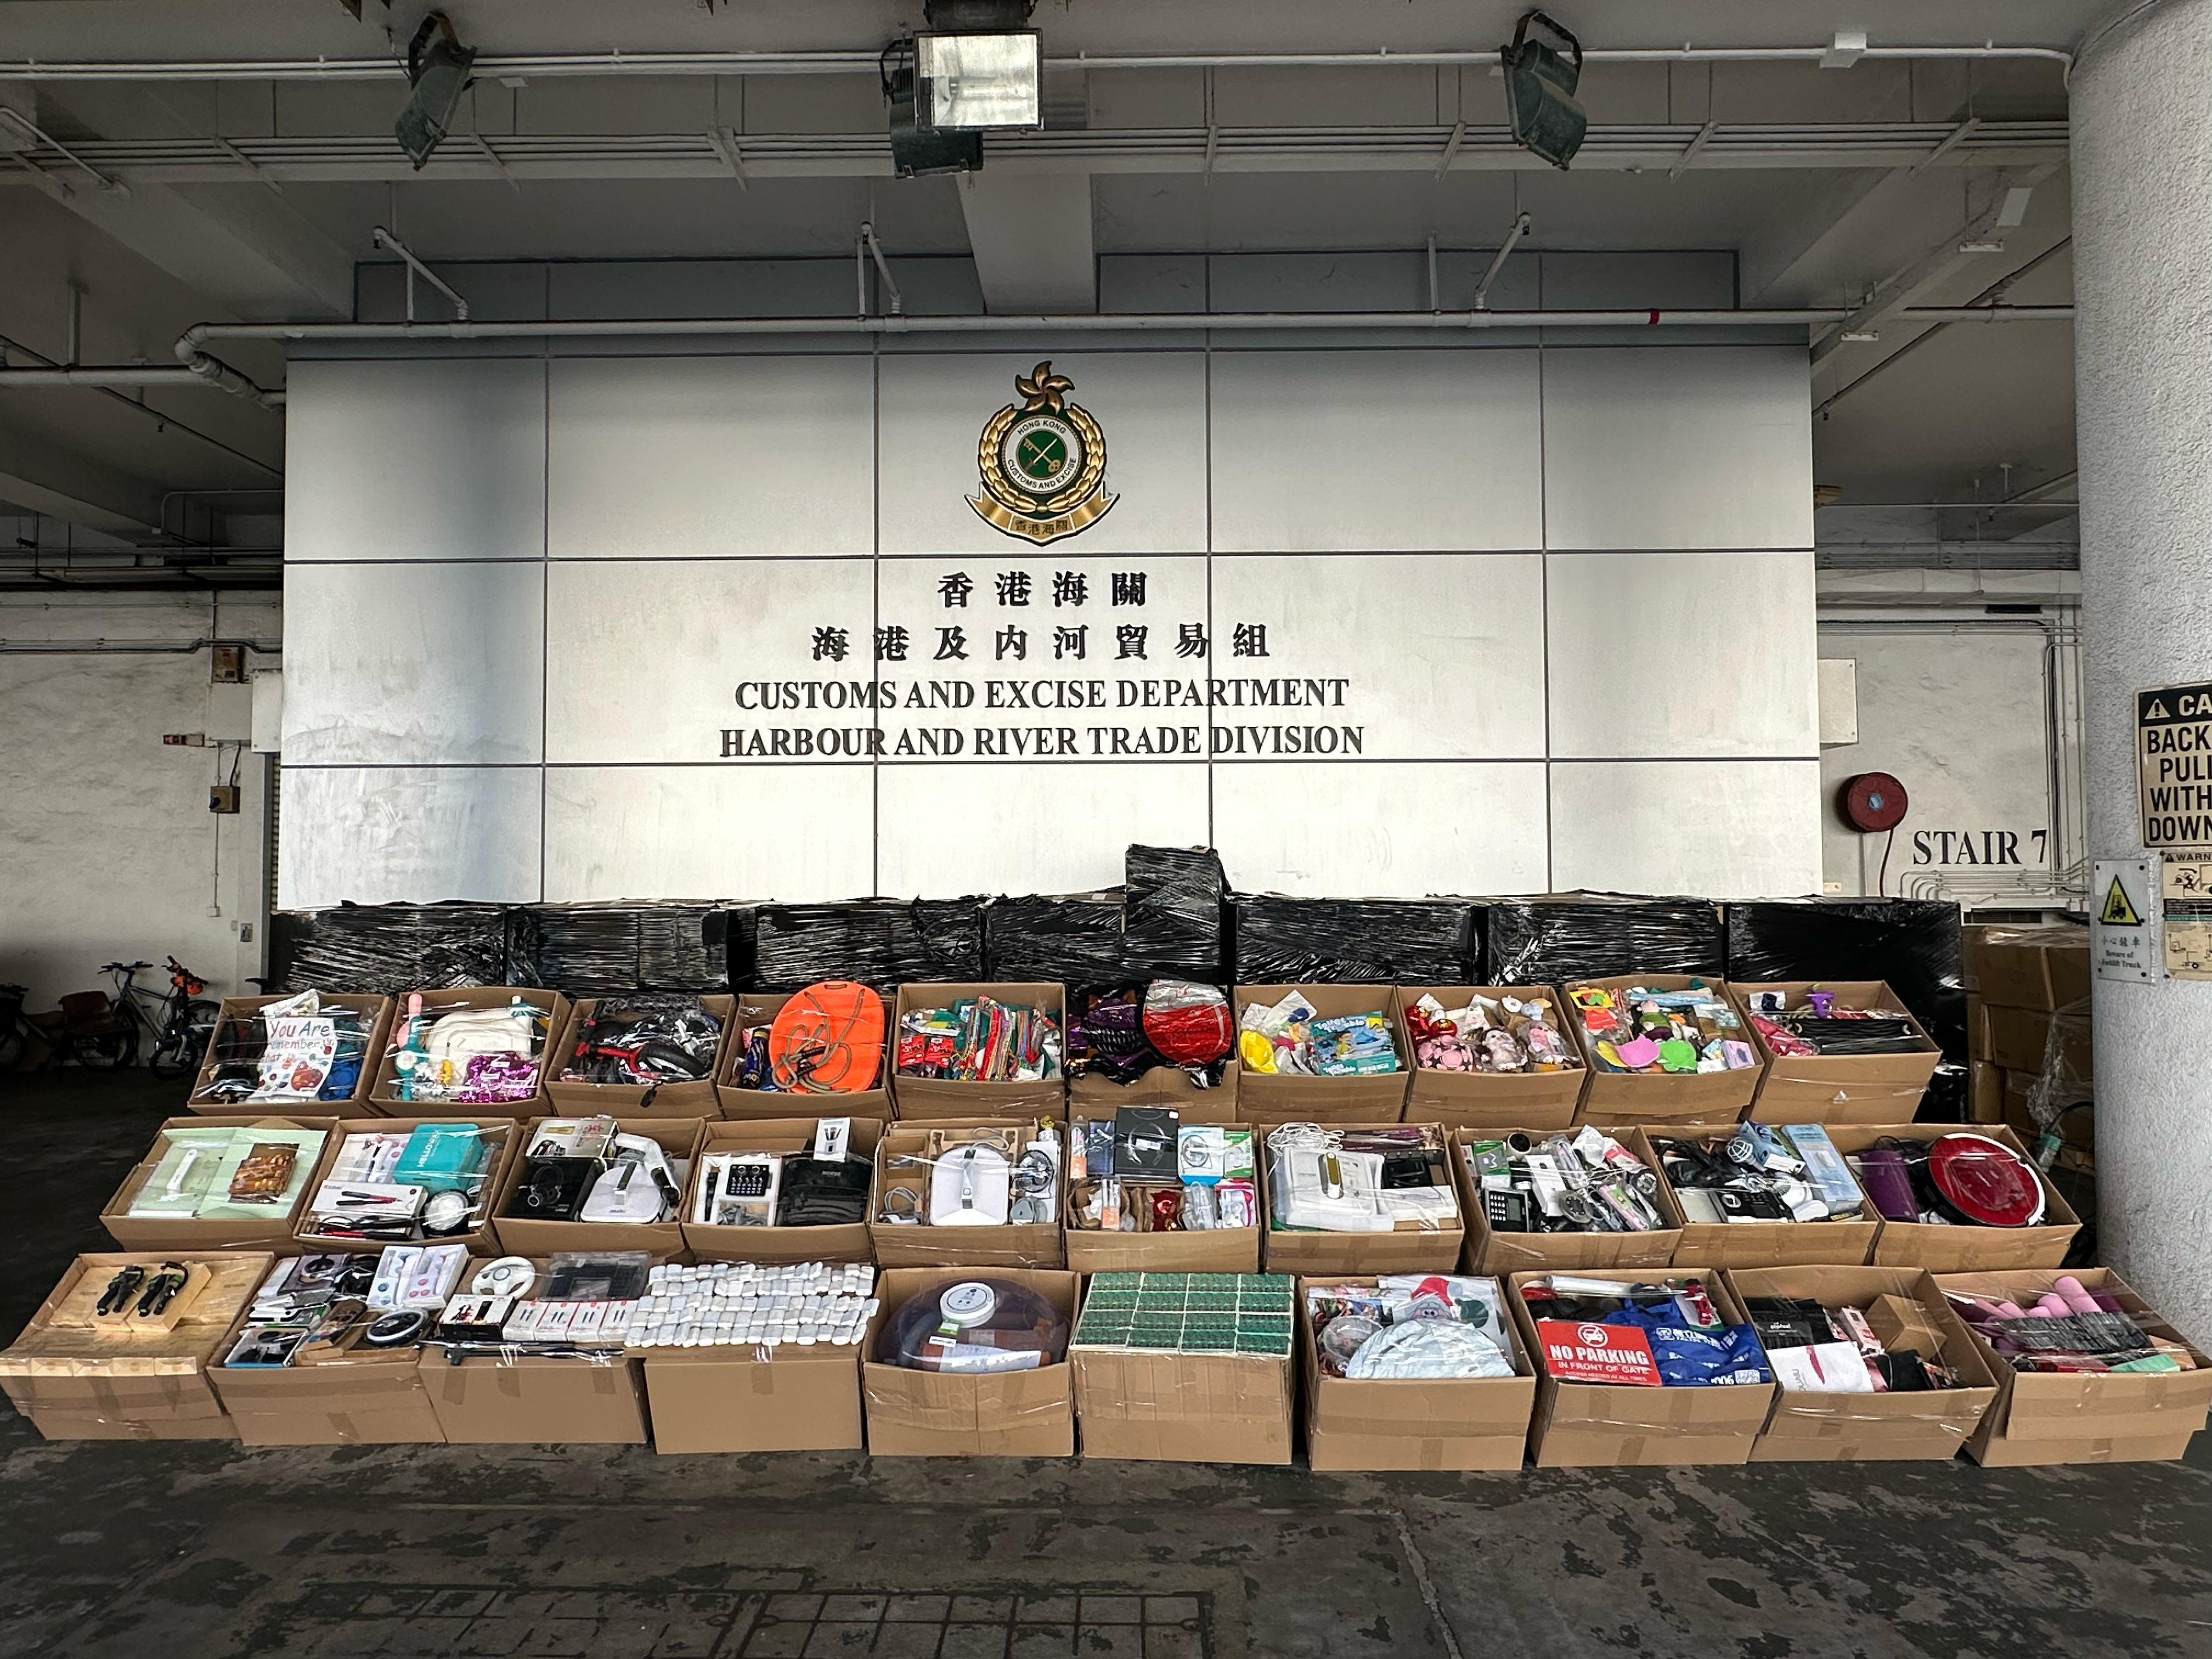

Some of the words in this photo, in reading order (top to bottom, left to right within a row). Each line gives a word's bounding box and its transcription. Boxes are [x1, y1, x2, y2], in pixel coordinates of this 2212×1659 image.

[1018, 420, 1040, 435] HONG
[1043, 420, 1066, 434] KONG
[1008, 459, 1037, 488] CUSTOMS
[1039, 480, 1056, 489] AND
[1057, 457, 1076, 487] EXCISE
[1015, 520, 1068, 535] 香港海關
[938, 571, 1147, 608] 香港海關
[735, 681, 896, 710] CUSTOMS
[904, 681, 974, 708] AND
[984, 680, 1106, 708] EXCISE
[1116, 679, 1350, 708] DEPARTMENT
[720, 728, 888, 757] HARBOUR
[894, 727, 964, 756] AND
[973, 727, 1080, 756] RIVER
[1087, 726, 1201, 754] TRADE
[1210, 725, 1364, 754] DIVISION
[2148, 725, 2211, 754] BACK
[2150, 785, 2212, 812] WITH
[1913, 831, 2022, 865] STAIR
[2031, 830, 2047, 864] 7
[2176, 853, 2211, 861] WARN
[269, 1020, 297, 1038] You
[298, 1020, 330, 1036] Are
[1549, 1344, 1573, 1360] NO
[1575, 1346, 1650, 1365] PARKING
[1570, 1362, 1602, 1371] FRONT
[1622, 1365, 1651, 1375] GATE
